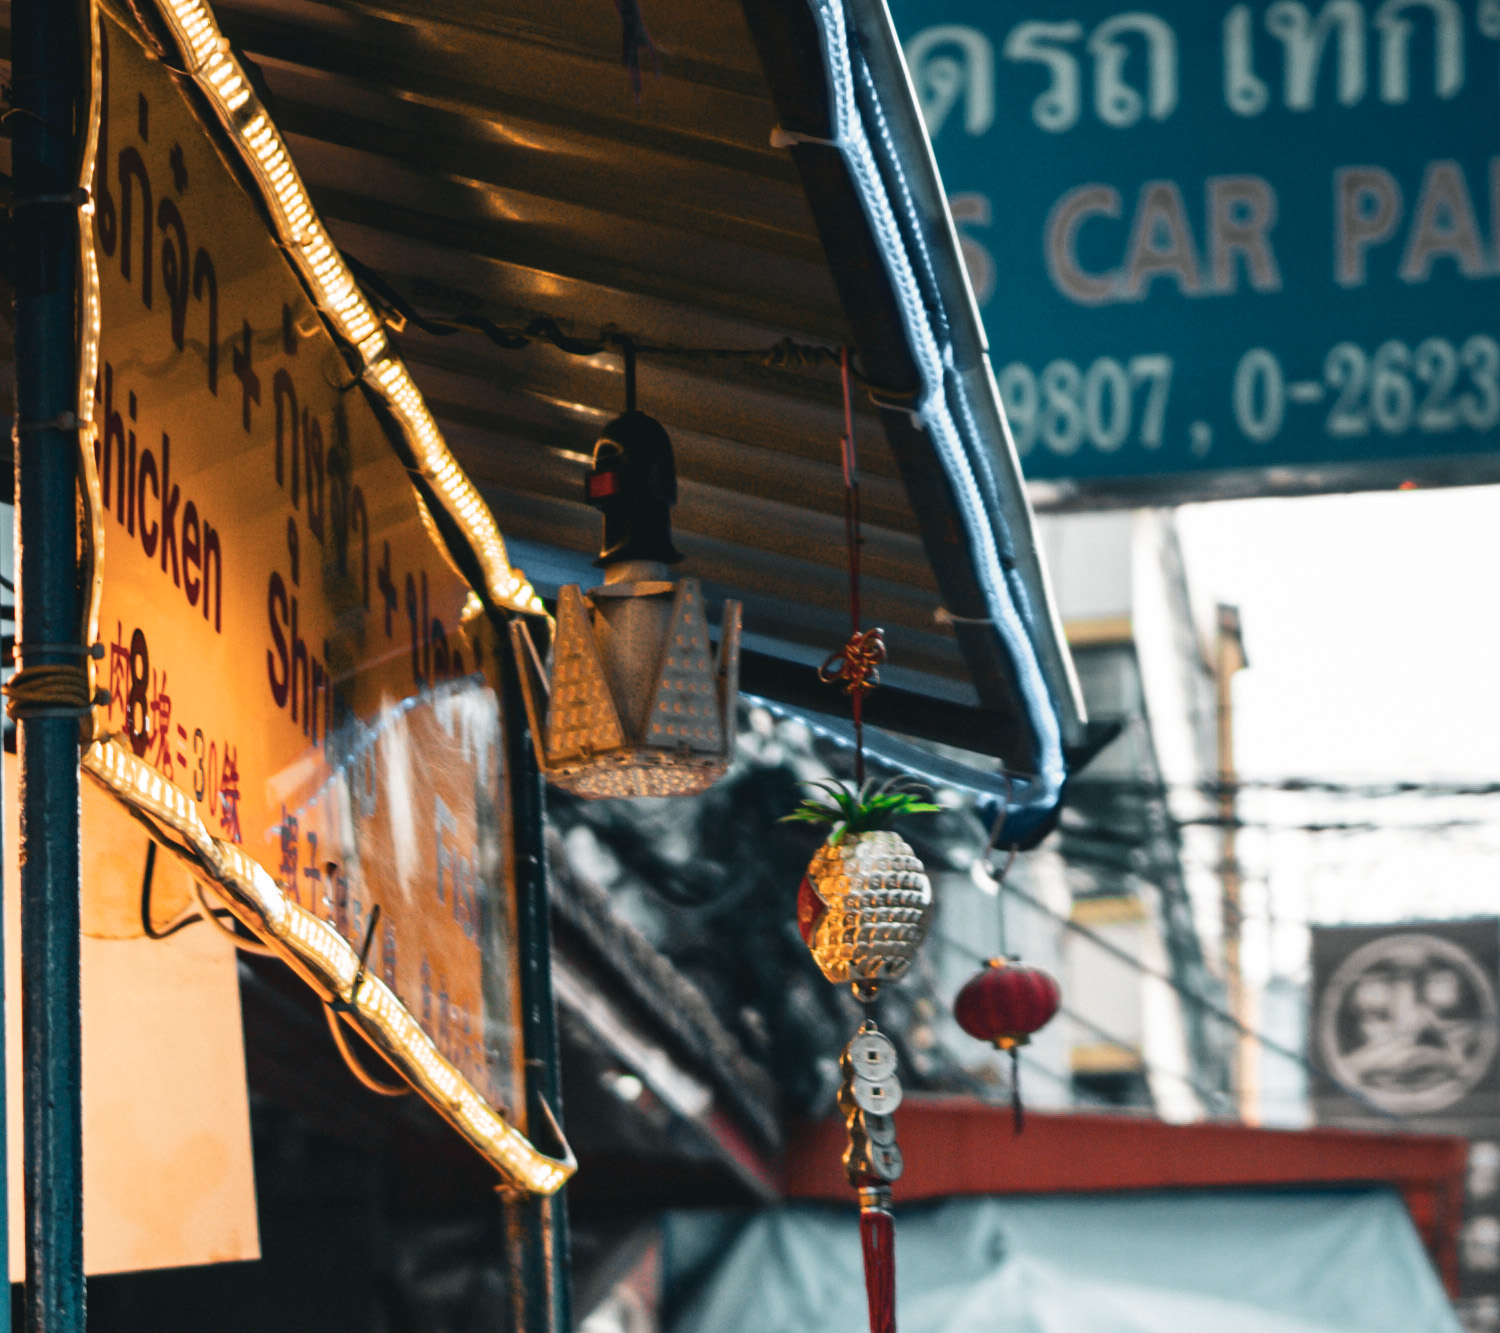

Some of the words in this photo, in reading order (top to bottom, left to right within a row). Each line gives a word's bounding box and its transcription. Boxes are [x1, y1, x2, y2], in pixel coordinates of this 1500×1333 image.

[907, 10, 1178, 137] ดรถ
[950, 192, 992, 308] S
[1045, 174, 1281, 307] CAR
[1004, 352, 1214, 457] 9807,
[96, 362, 224, 634] hicken
